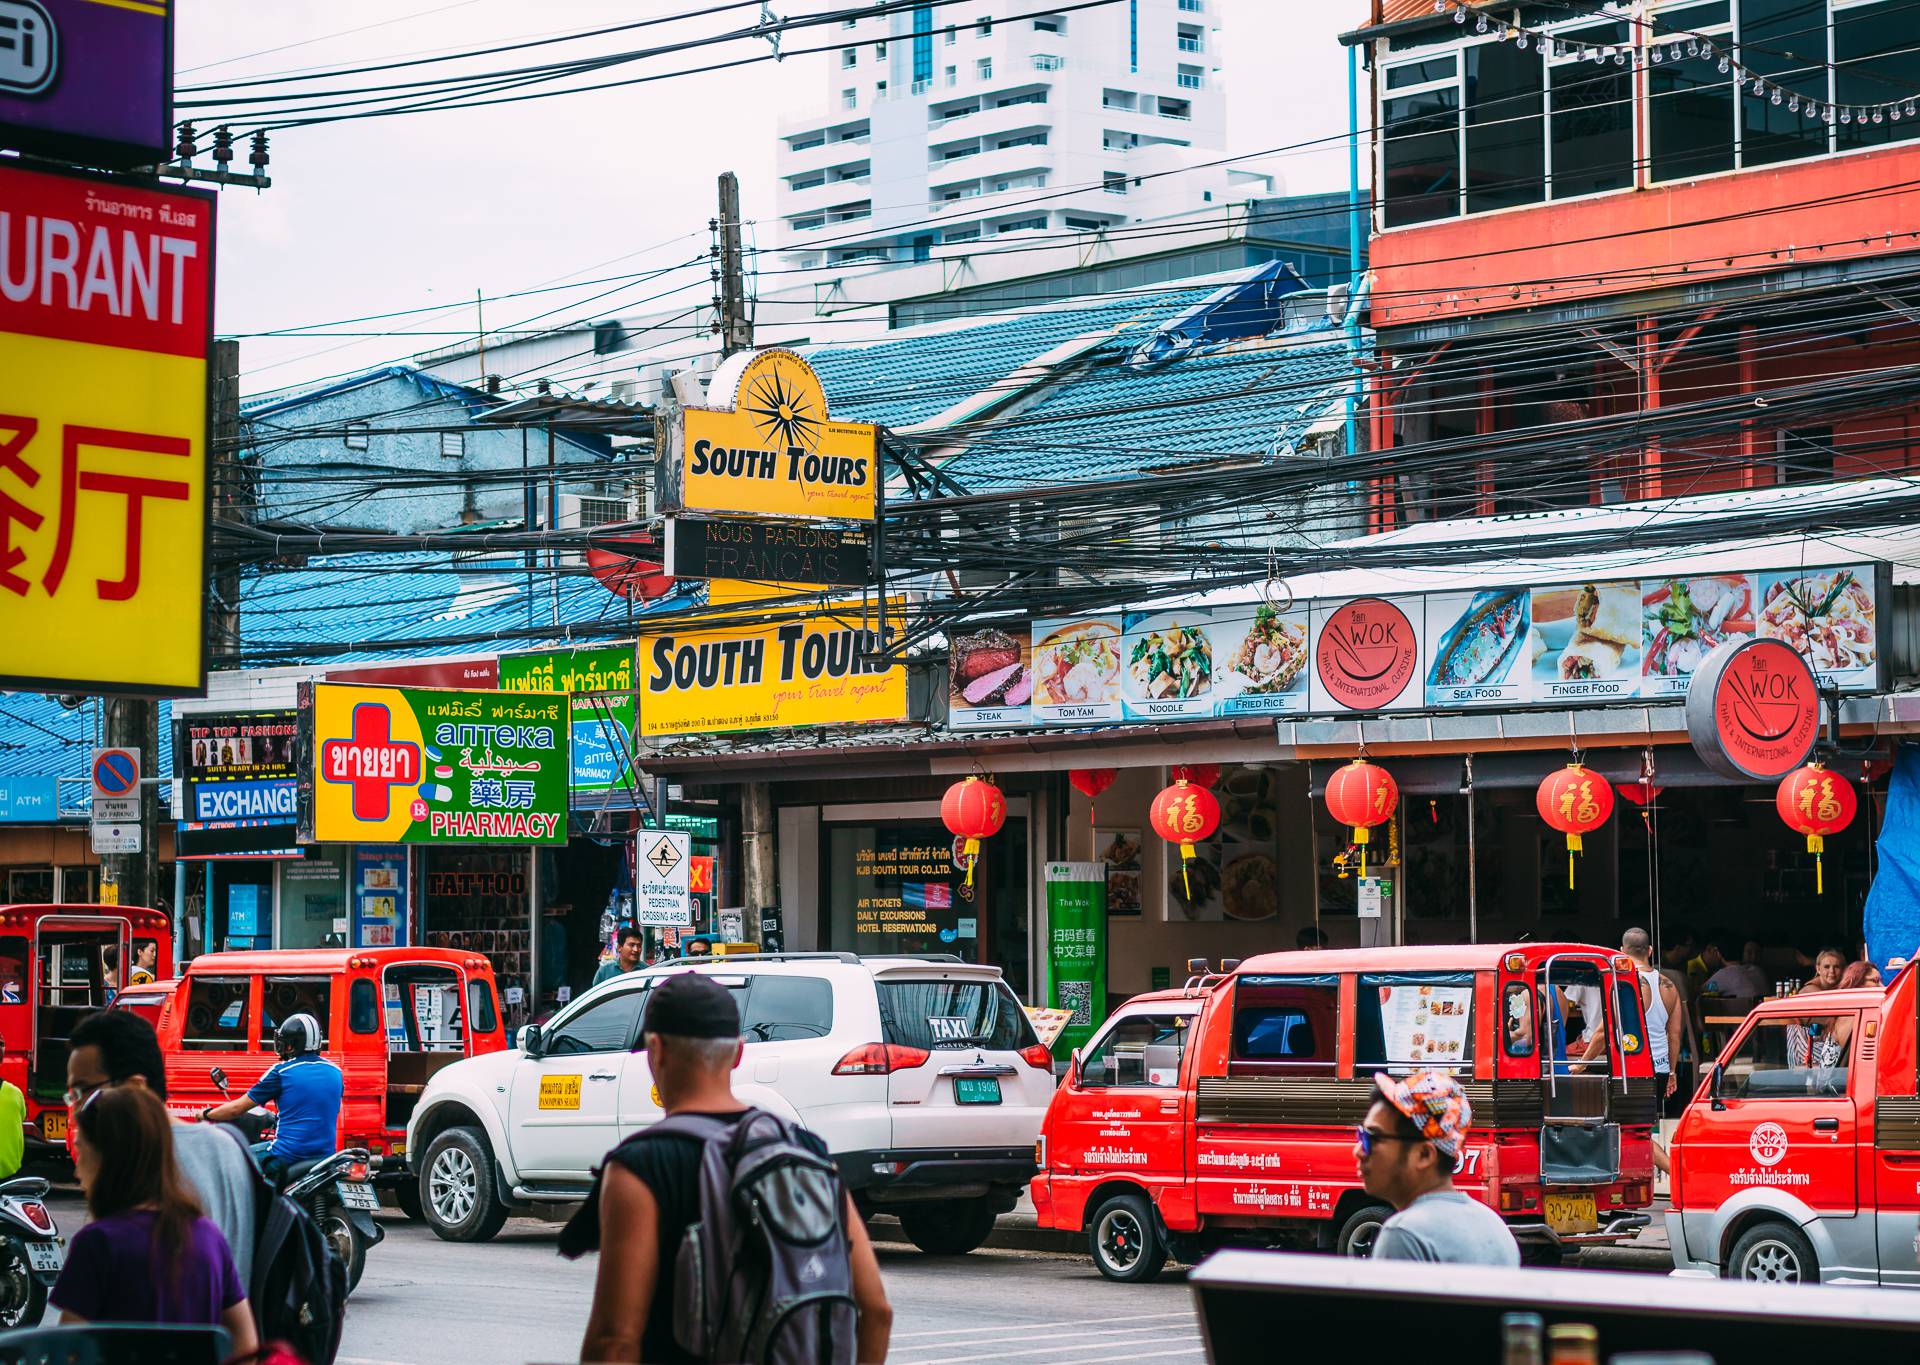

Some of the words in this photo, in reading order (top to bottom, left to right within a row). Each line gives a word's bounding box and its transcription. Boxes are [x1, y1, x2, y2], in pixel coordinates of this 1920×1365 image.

[85, 190, 153, 221] ร้านอาหาร
[691, 440, 778, 480] SOUTH
[787, 446, 868, 487] TOURS
[706, 523, 752, 543] NOUS
[765, 527, 839, 549] PARLONS
[1350, 623, 1398, 646] WOK
[649, 636, 766, 693] SOUTH
[777, 624, 894, 682] TOUR
[561, 658, 630, 692] ฟาร์มาซี
[1322, 651, 1333, 675] THAI
[1334, 678, 1390, 697] INTERNATIONAL
[1391, 647, 1412, 685] CUISINE
[772, 686, 804, 713] your
[808, 678, 846, 699] travel
[850, 677, 895, 704] agent
[1453, 689, 1473, 699] SEA
[1475, 688, 1502, 698] FOOD
[1552, 685, 1589, 695] FINGER
[1592, 683, 1620, 694] FOOD
[1750, 673, 1799, 700] WOK
[427, 698, 482, 717] แฟมิลี่
[492, 702, 559, 720] ฟาร์มาซี
[1058, 707, 1075, 717] TOM
[1076, 706, 1094, 717] YAM
[1149, 703, 1184, 714] NOODLE
[1235, 698, 1261, 709] FRIED
[1262, 697, 1285, 708] RICE
[976, 711, 1002, 721] STEAK
[190, 727, 210, 738] TIP
[212, 726, 238, 737] TOP
[435, 722, 555, 749] аптека
[1720, 703, 1729, 730] THAI
[1734, 734, 1792, 760] INTERNATIONAL
[1793, 706, 1815, 747] CUISINE
[207, 765, 227, 773] SUITS
[229, 765, 250, 773] READY
[272, 763, 286, 771] HRS
[331, 744, 410, 778] ขายยา
[459, 748, 541, 778] صيدلية
[16, 796, 41, 806] ATM
[469, 778, 537, 810] 藥房
[1560, 780, 1601, 823] 福
[1799, 777, 1842, 822] 福
[1166, 794, 1204, 833] 福
[431, 811, 560, 839] PHARMACY
[856, 865, 870, 876] KJB
[872, 865, 897, 875] SOUTH
[899, 865, 919, 875] TOUR
[921, 864, 952, 875] CO.,LTD.
[428, 872, 526, 897] TATTOO
[649, 898, 680, 908] PEDESTRIAN
[857, 898, 870, 908] AIR
[872, 898, 902, 908] TICKETS
[1059, 898, 1072, 907] The
[231, 911, 245, 921] ATM
[643, 911, 669, 921] CROSSING
[670, 912, 687, 922] AHEAD
[857, 911, 878, 920] DAILY
[880, 911, 926, 920] EXCURSIONS
[857, 924, 880, 933] HOTEL
[882, 923, 937, 933] RESERVATIONS
[1054, 928, 1096, 942] 扫码查看
[1054, 944, 1096, 958] 中文菜单
[930, 1018, 970, 1038] TAXI
[1083, 1146, 1148, 1164] รถรับจ้างไม่ประจำทาง
[1729, 1168, 1810, 1185] รถรับจ้างไม่ประจำทาง
[1284, 1193, 1289, 1206] 9
